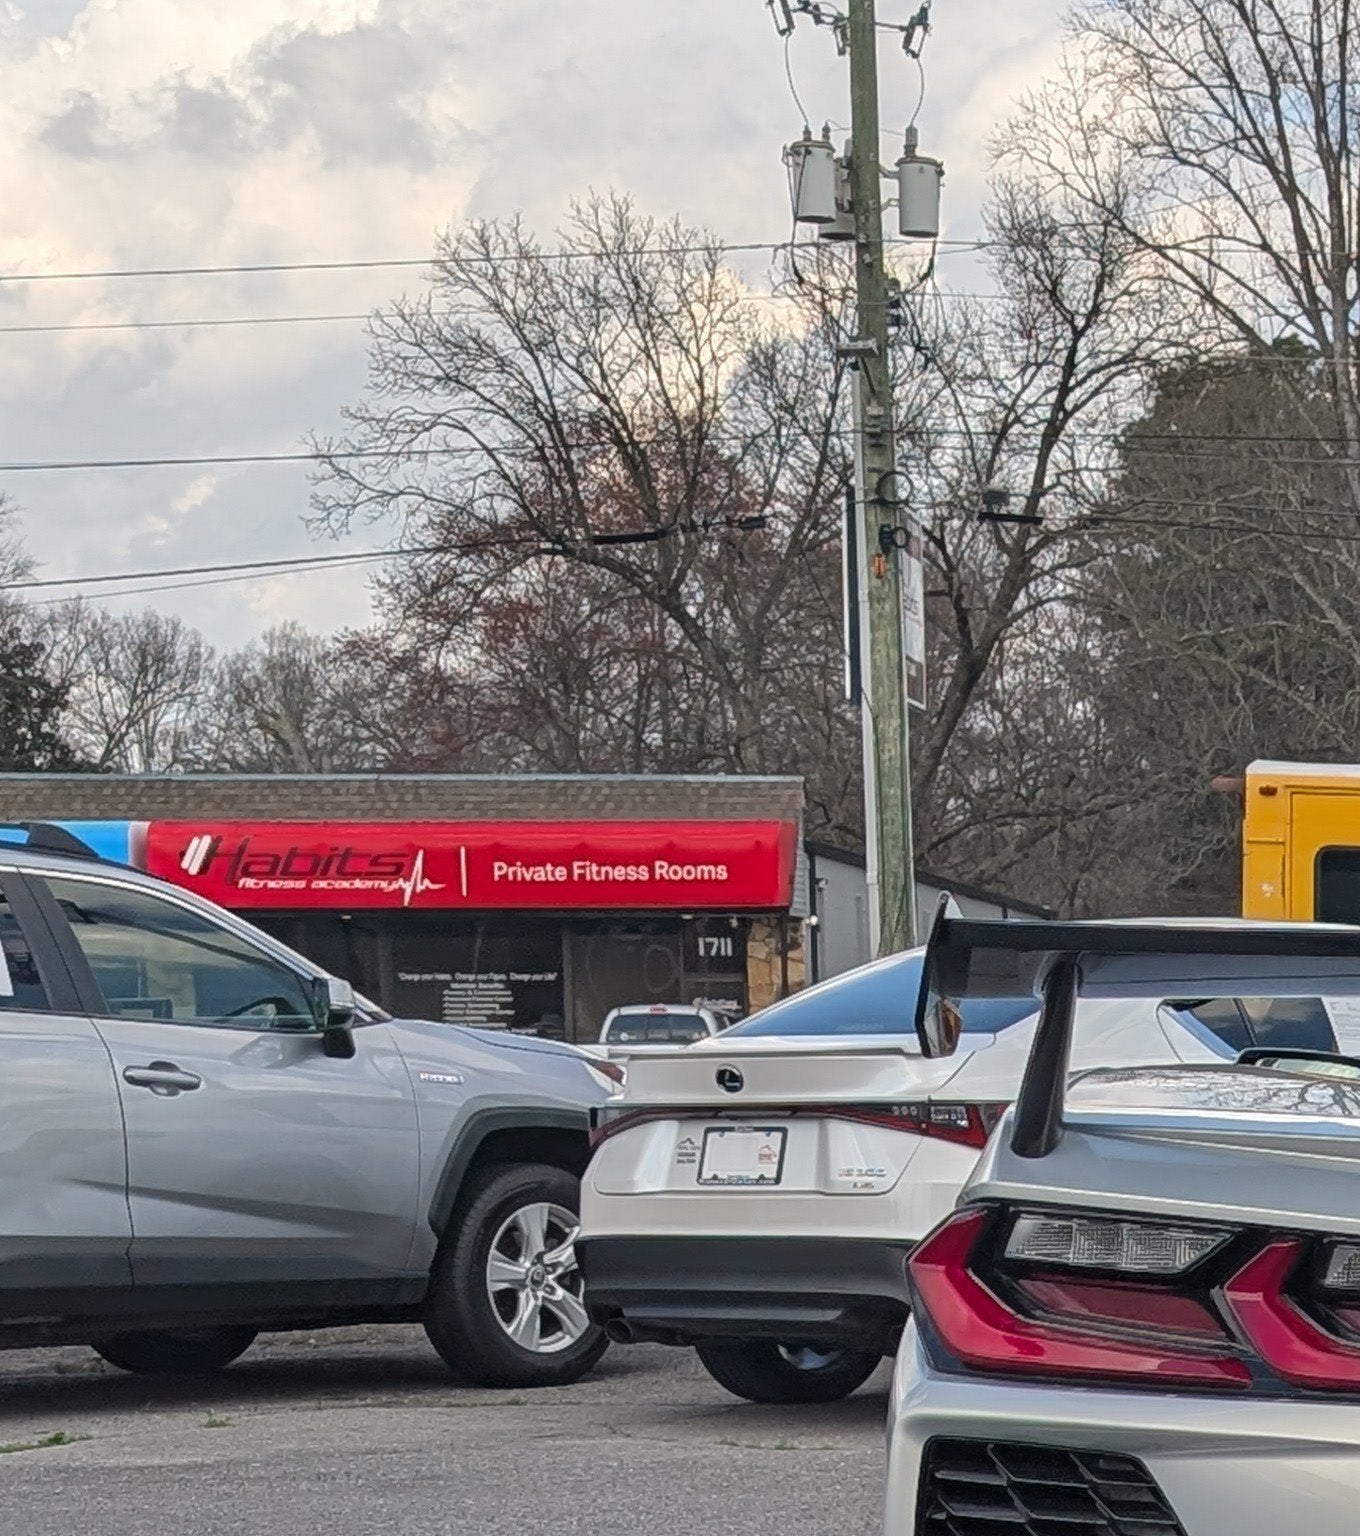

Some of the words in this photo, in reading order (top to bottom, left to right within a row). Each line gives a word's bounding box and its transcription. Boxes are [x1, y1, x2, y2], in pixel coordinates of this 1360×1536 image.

[196, 835, 409, 885] Habits
[493, 861, 567, 882] Private
[572, 860, 649, 882] Fitness
[654, 861, 728, 881] Rooms
[237, 877, 307, 889] fitness
[311, 877, 398, 892] academy
[698, 937, 733, 957] 1711
